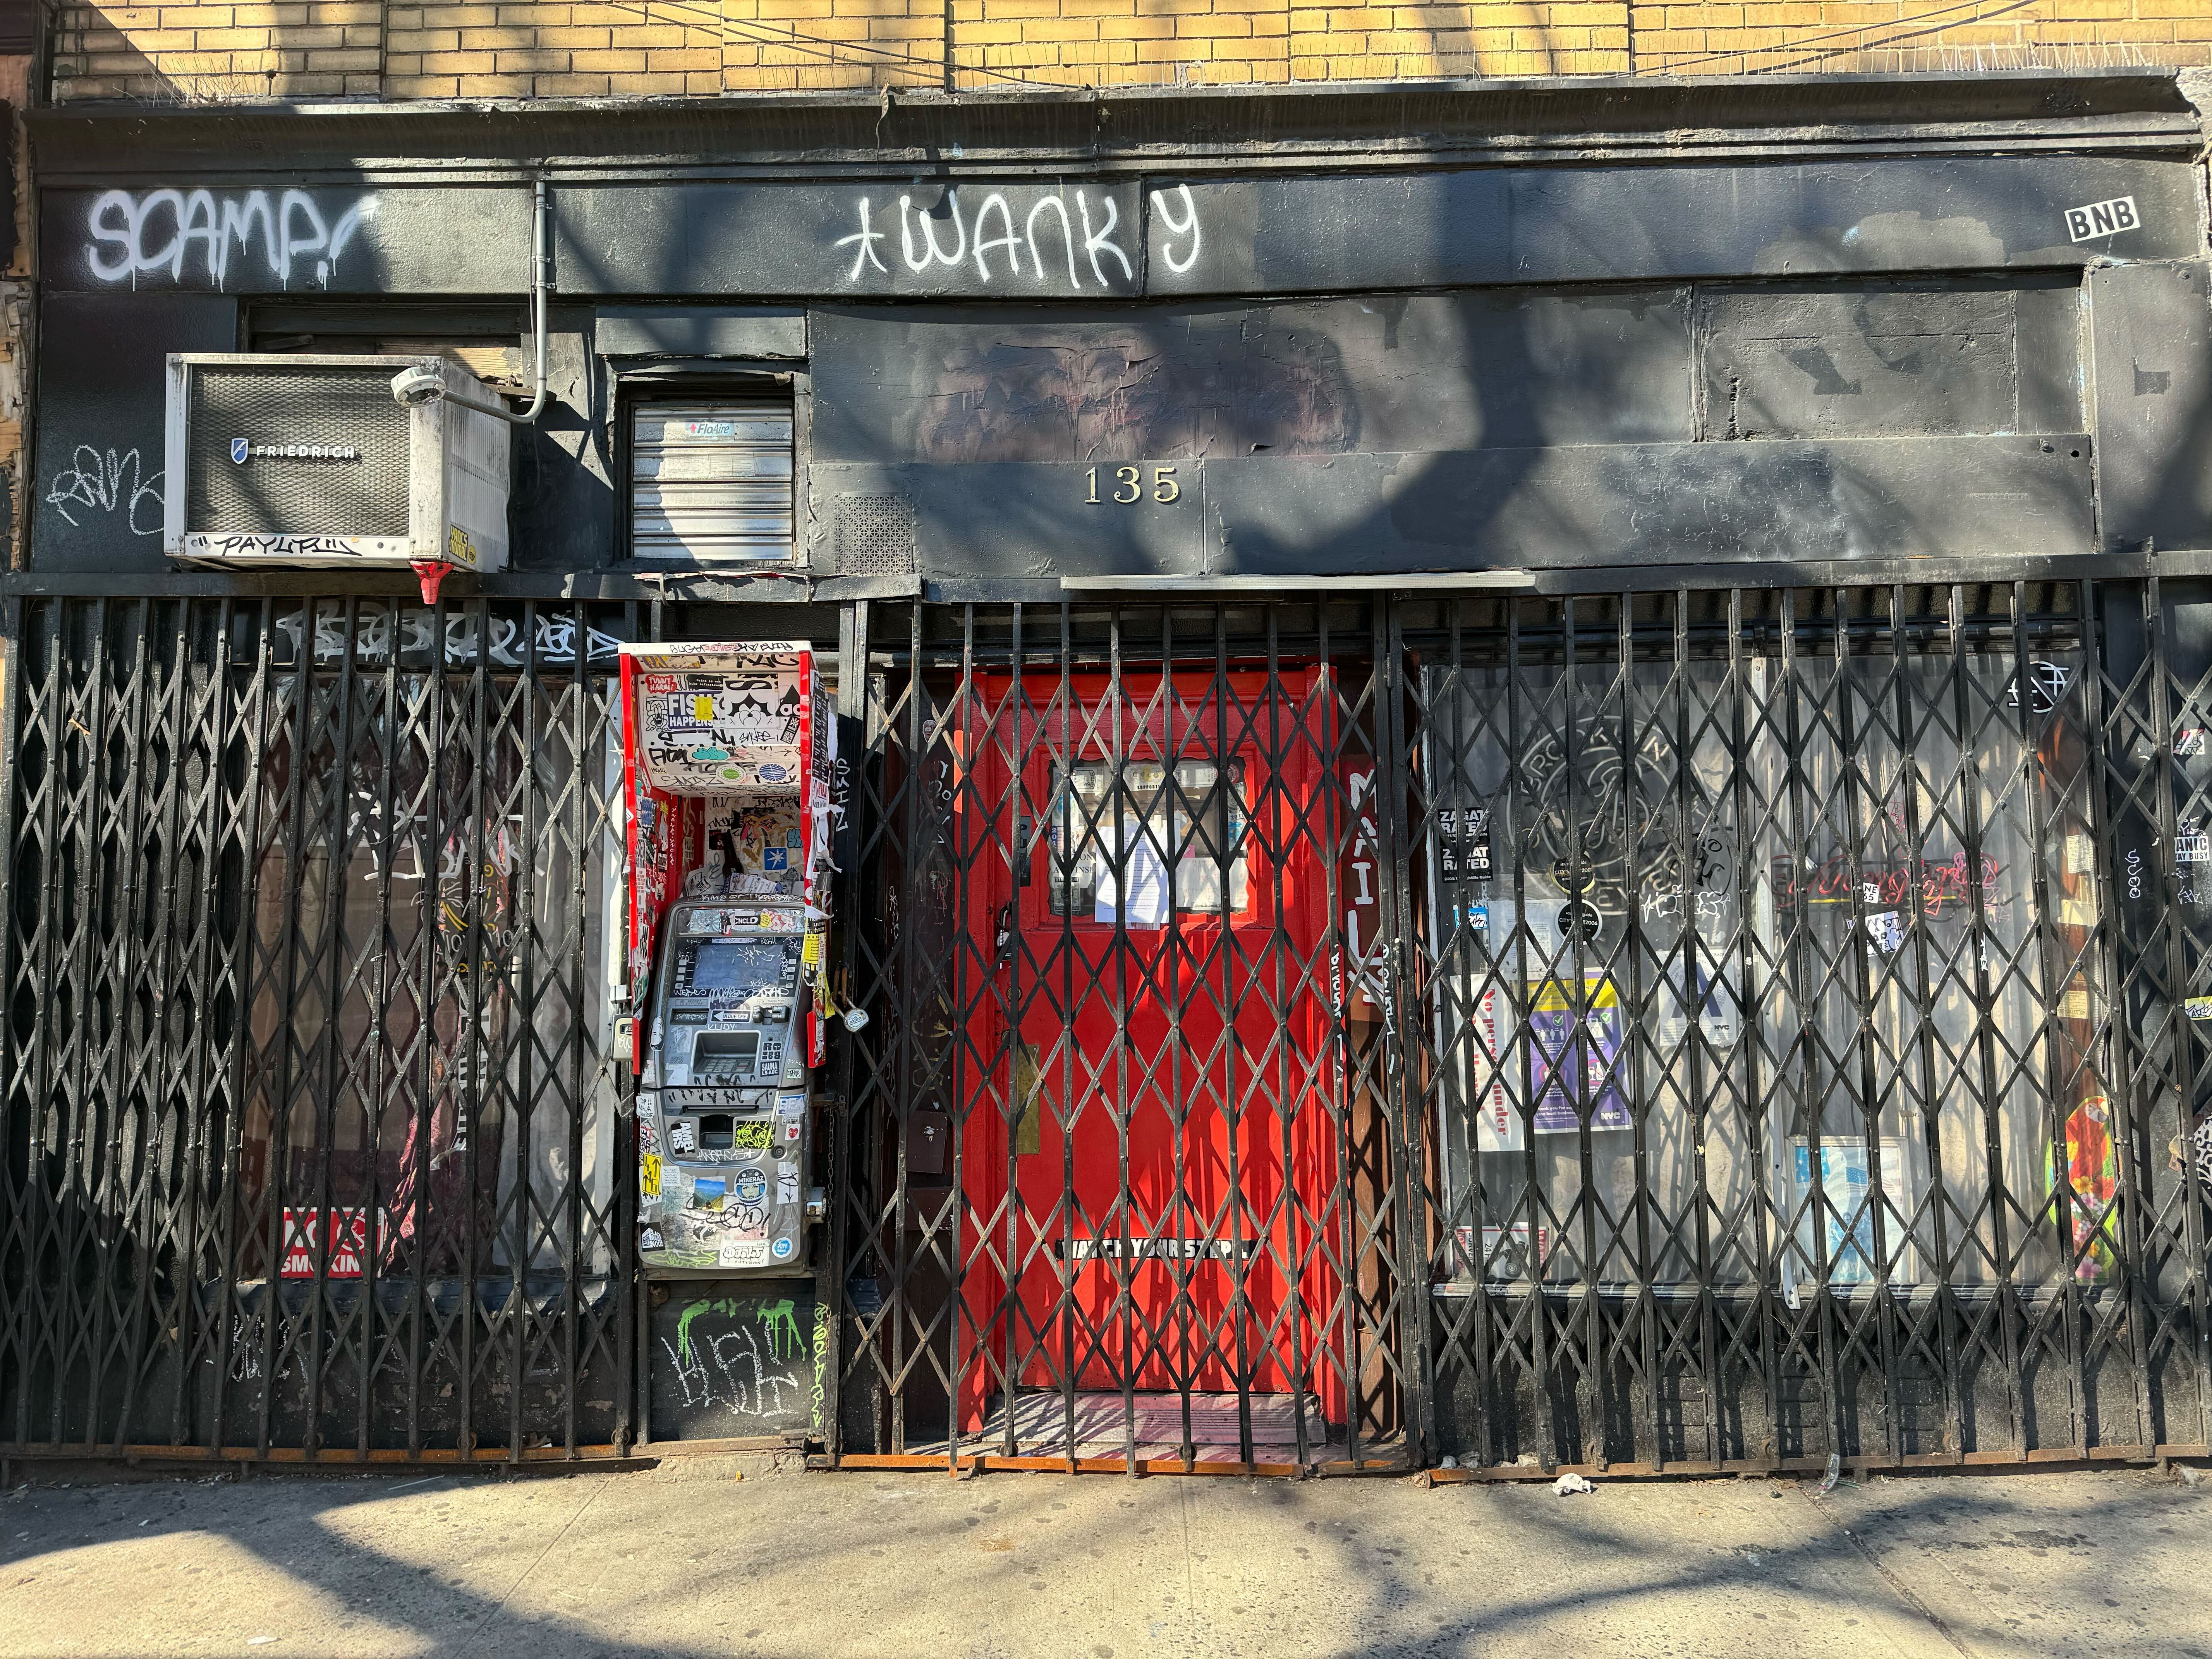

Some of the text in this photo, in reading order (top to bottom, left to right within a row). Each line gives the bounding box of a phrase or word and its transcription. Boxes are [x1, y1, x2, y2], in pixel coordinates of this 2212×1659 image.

[2069, 200, 2134, 239] BNB
[697, 423, 729, 434] FloAire
[256, 445, 355, 459] FRIEDRICH
[1085, 467, 1179, 503] 135
[649, 676, 670, 684] FUNNY
[668, 694, 712, 715] FISH
[670, 716, 713, 727] HAPPENS
[2176, 838, 2207, 852] ANIC
[1443, 846, 1489, 859] ZAT
[2189, 852, 2208, 860] BUSY
[762, 1062, 778, 1071] SAUNA
[1131, 1239, 1177, 1258] YOUR
[1185, 1240, 1232, 1258] STEP
